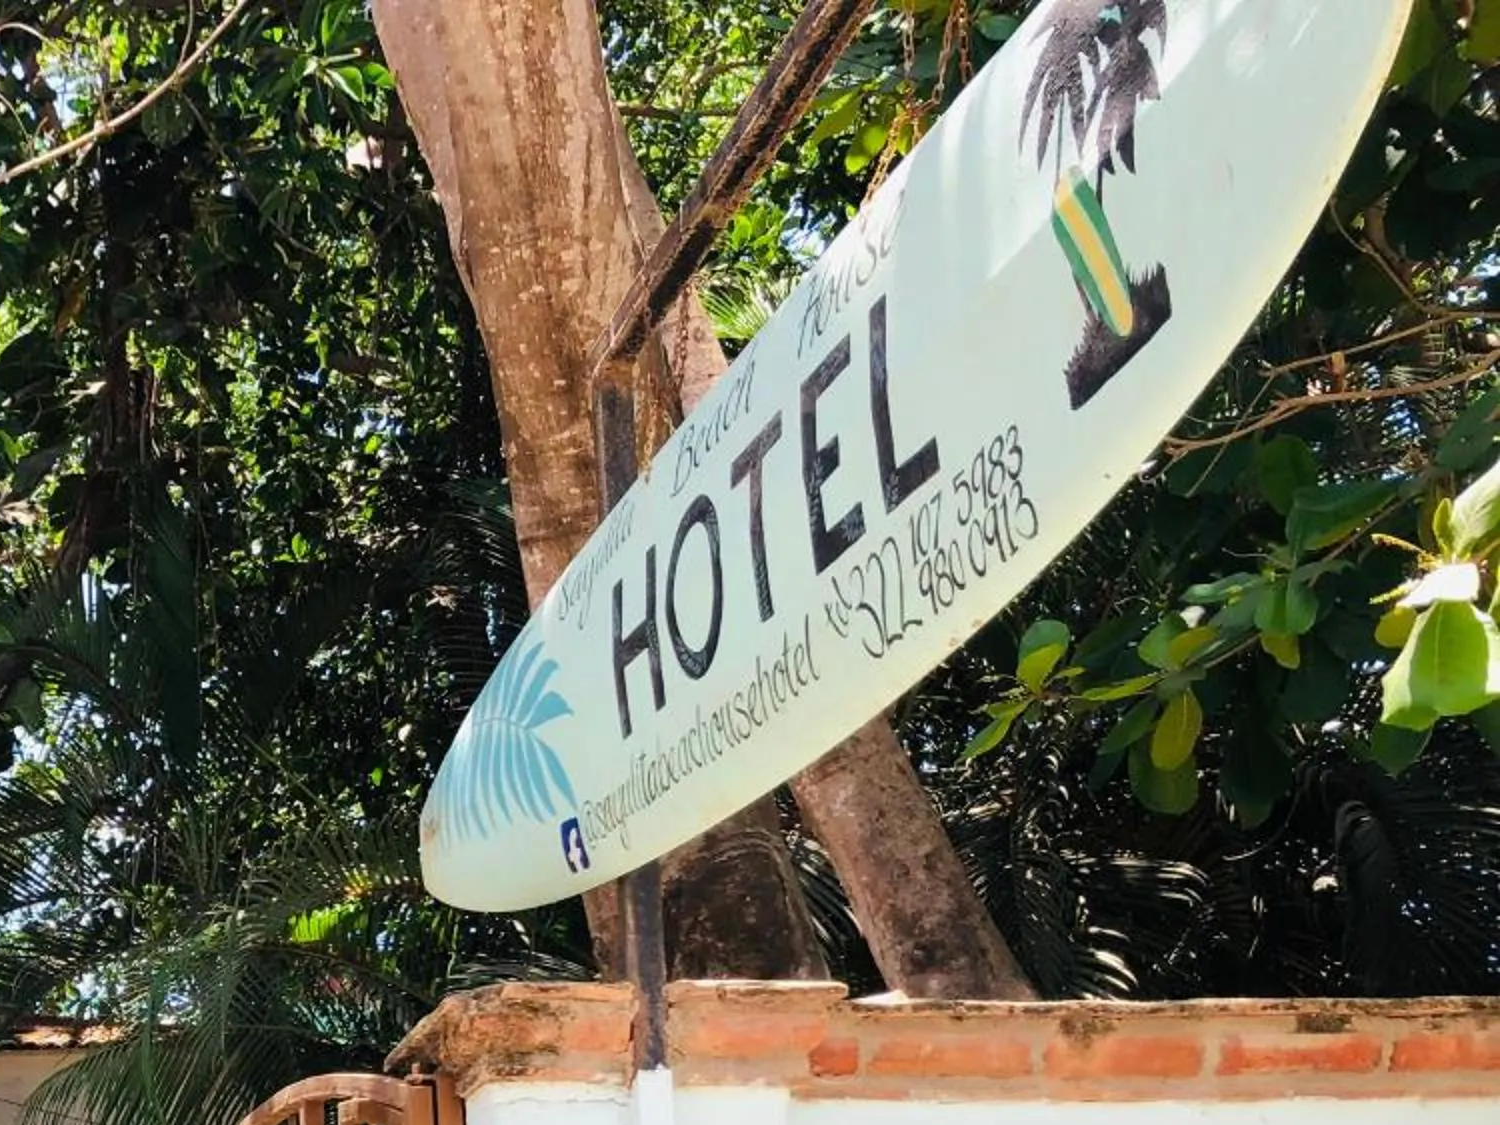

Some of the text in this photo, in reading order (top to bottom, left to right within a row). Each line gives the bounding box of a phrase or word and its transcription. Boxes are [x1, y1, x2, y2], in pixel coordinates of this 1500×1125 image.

[612, 293, 942, 740] HOTEL
[670, 343, 758, 498] Beach
[850, 536, 923, 659] 322
[908, 491, 941, 567] 107
[952, 425, 1023, 526] 5983
[918, 480, 1039, 615] 980 0913
